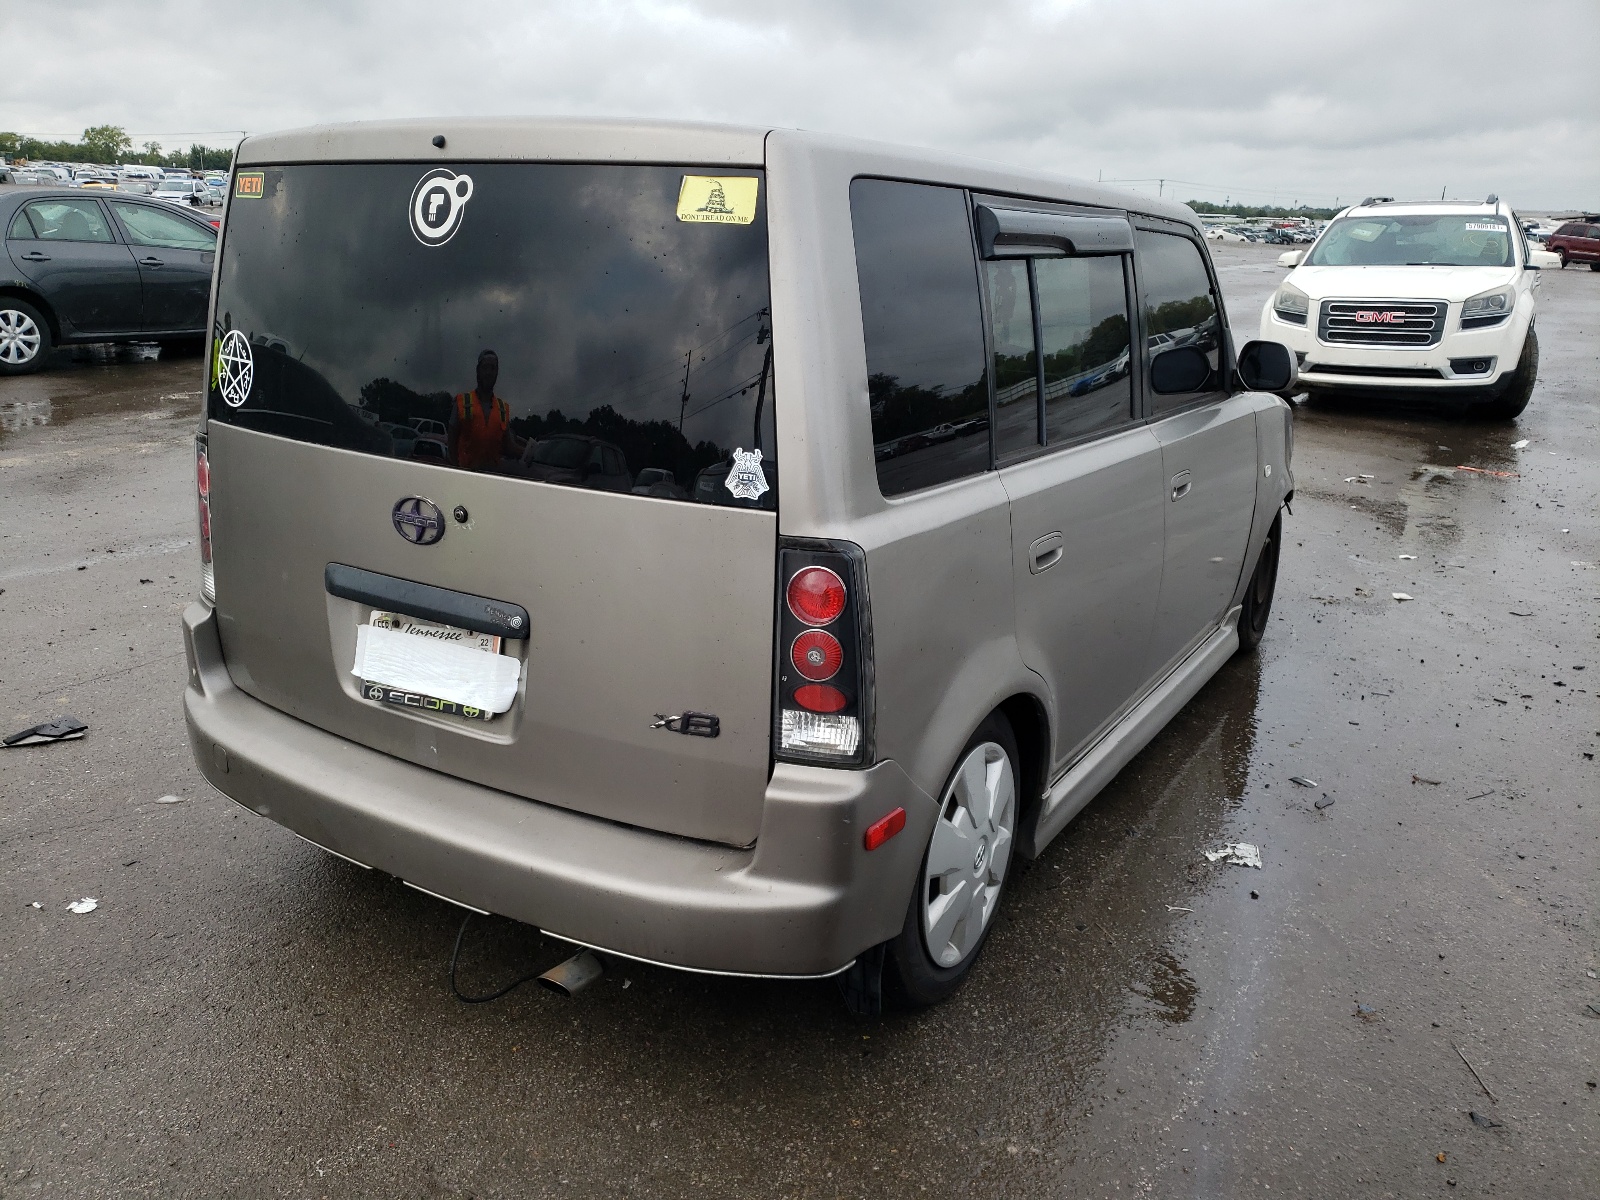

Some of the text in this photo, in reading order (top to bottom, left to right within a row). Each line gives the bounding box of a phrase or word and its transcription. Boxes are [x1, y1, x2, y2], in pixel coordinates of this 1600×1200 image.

[239, 177, 262, 193] YETI
[700, 214, 725, 222] TREAD
[725, 214, 737, 222] ON
[737, 215, 749, 223] ME
[1355, 311, 1406, 323] GMC
[738, 473, 757, 481] YETI
[404, 623, 464, 641] Tennessee
[480, 638, 489, 647] 22
